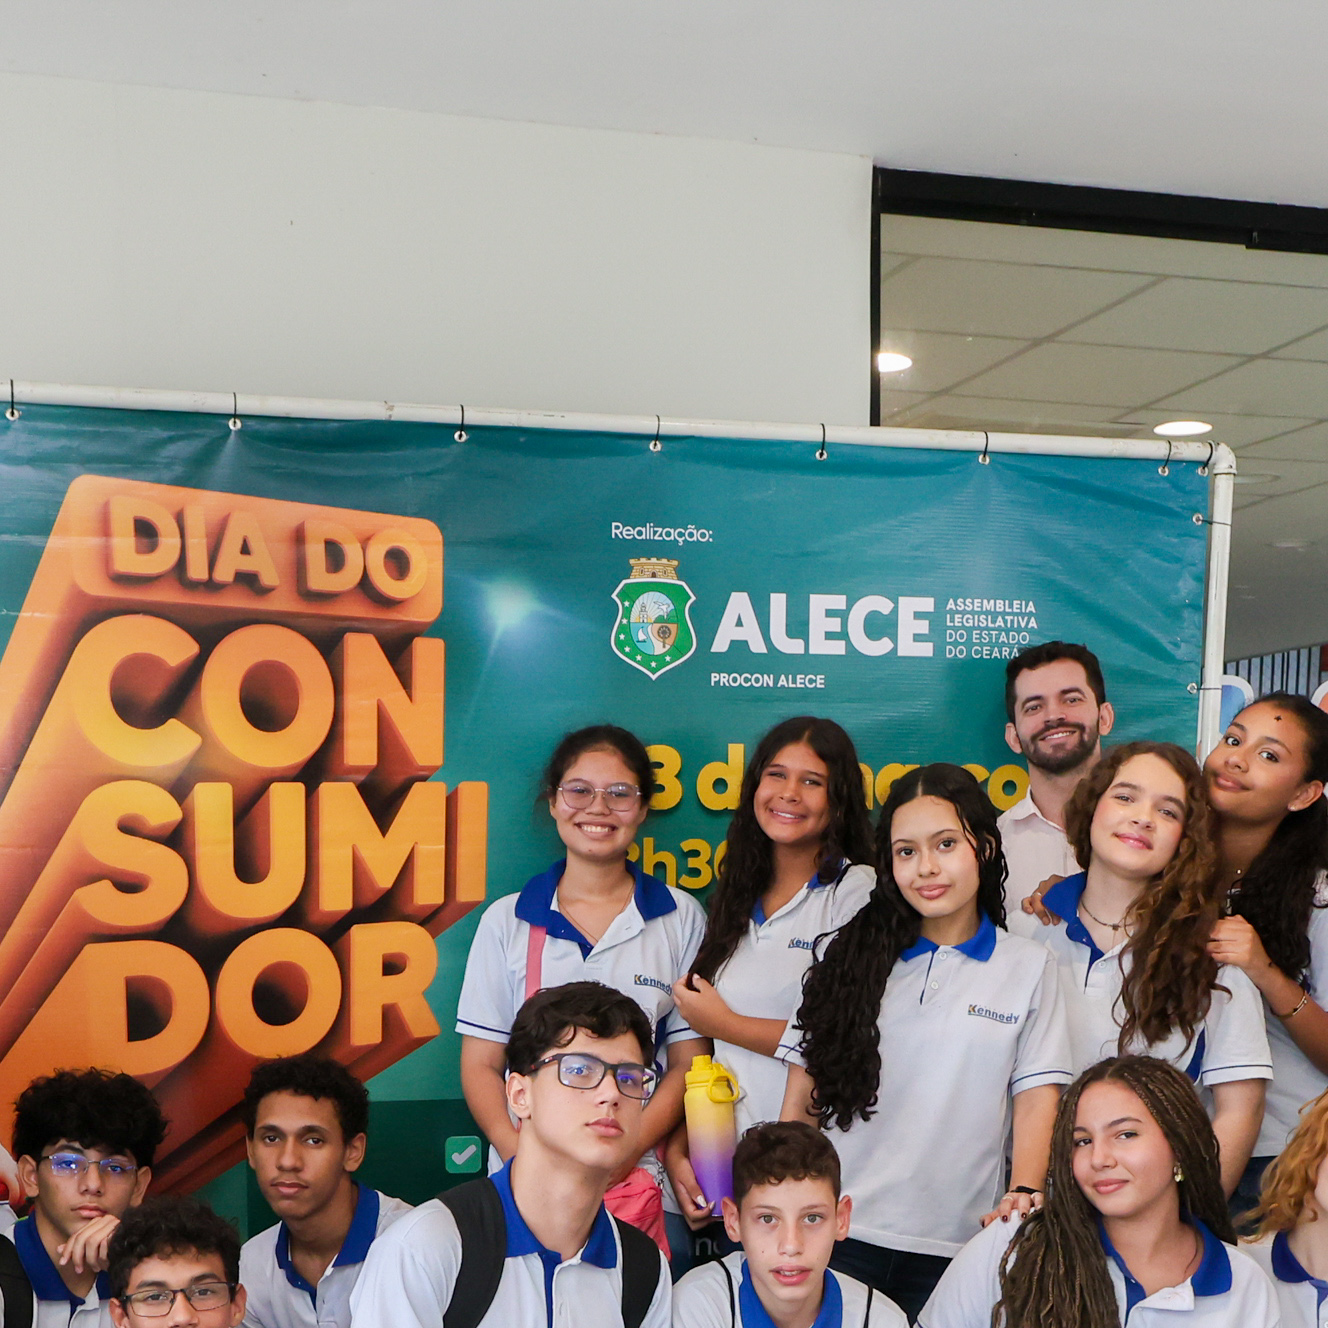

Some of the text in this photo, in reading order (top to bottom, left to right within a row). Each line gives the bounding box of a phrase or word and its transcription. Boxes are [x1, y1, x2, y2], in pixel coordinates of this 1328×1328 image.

[109, 497, 428, 600] DIA DO
[611, 522, 713, 546] Realização:
[710, 591, 935, 657] ALECE
[946, 598, 1036, 613] ASSEMBLEIA
[946, 614, 1038, 629] LEGISLATIVA
[946, 630, 1030, 644] DO ESTADO
[946, 645, 1019, 659] DO CEARÁ
[72, 613, 445, 768] CON
[711, 673, 825, 688] PROCON ALECE
[646, 743, 745, 811] 3 d
[71, 779, 489, 926] SUMI
[627, 836, 730, 890] h3
[80, 920, 441, 1077] DOR
[968, 1003, 1020, 1025] Kennedy
